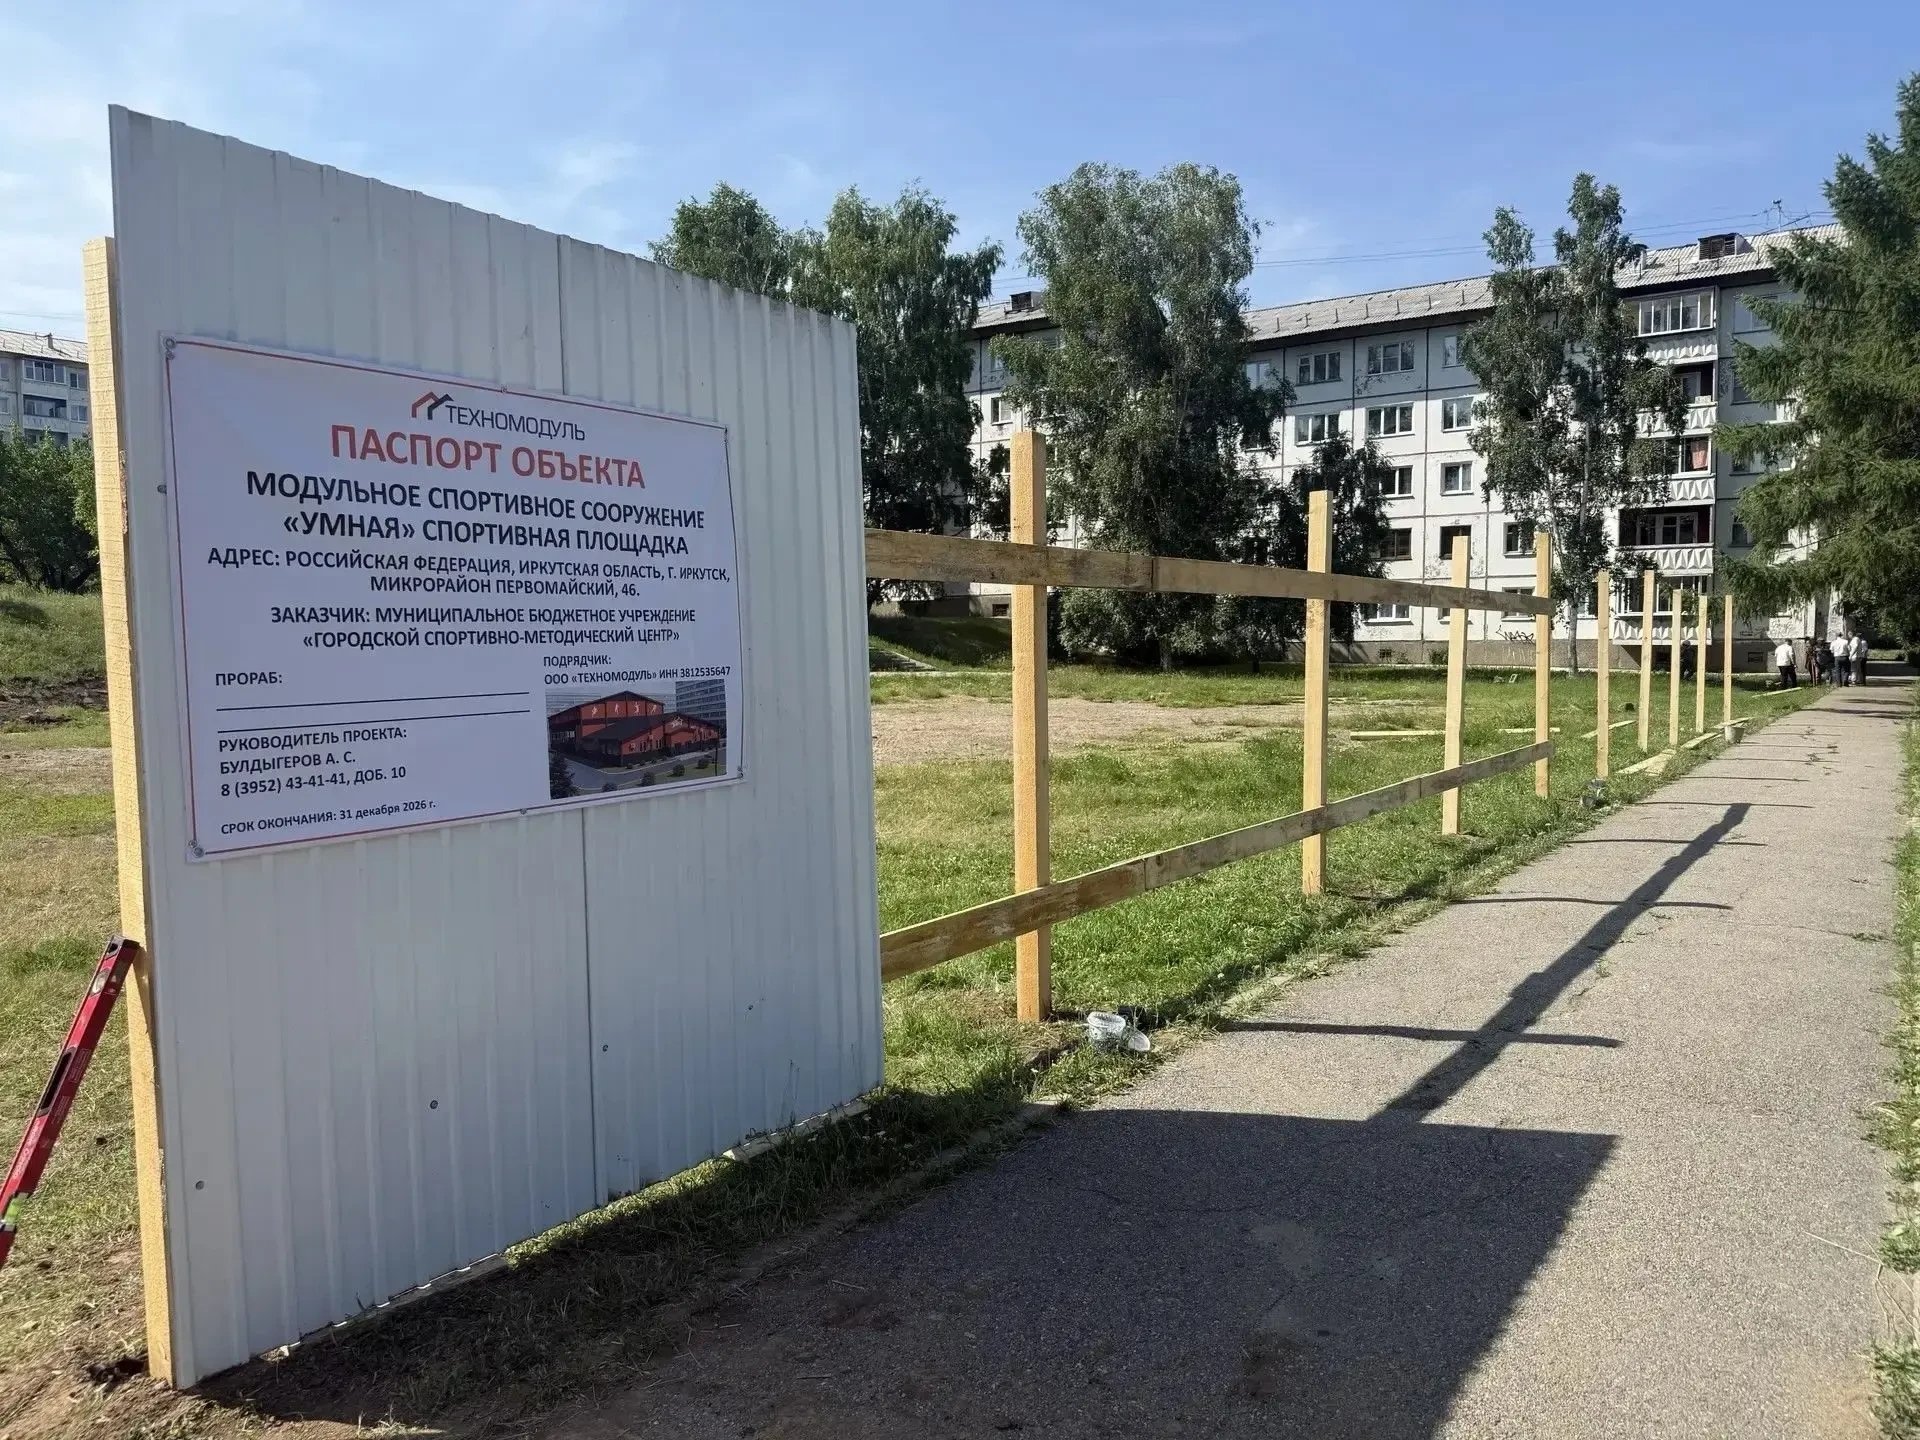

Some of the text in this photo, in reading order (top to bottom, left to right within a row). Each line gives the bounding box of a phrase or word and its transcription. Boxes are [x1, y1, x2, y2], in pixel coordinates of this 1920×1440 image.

[445, 404, 586, 441] ТЕХНОМОДУЛЬ
[331, 424, 646, 489] ПАСПОРТ ОБЪЕКТА
[246, 471, 705, 529] МОДУЛЬНОЕ СПОРТИВНОЕ СООРУЖЕНИЕ
[283, 511, 689, 558] «УМНАЯ» СПОРТИВНАЯ ПЛОЩАДКА
[207, 548, 731, 582] АДРЕС: РОССИЙСКАЯ ФЕДЕРАЦИЯ, ИРКУТСКАЯ ОБЛАСТЬ, Г. ИРКУТСК,
[370, 575, 640, 598] МИКРОРАЙОН ПЕРВОМАЙСКИЙ, 46.
[271, 606, 696, 625] ЗАКАЗЧИК: МУНИЦИПАЛЬНОЕ БЮДЖЕТНОЕ УЧРЕЖДЕНИЕ
[303, 627, 680, 650] «ГОРОДСКОЙ СПОРТИВНО-МЕТОДИЧЕСКИЙ ЦЕНТР»
[543, 655, 612, 668] ПОДРЯДЧИК:
[215, 671, 283, 686] ПРОРАБ:
[544, 666, 731, 685] ООО «ТЕХНОМОДУЛЬ» ИНН 3812535647
[219, 727, 407, 752] РУКОВОДИТЕЛЬ ПРОЕКТА:
[219, 751, 356, 775] БУЛДЫГЕРОВ А. С.
[220, 766, 407, 798] 8 (3952) 43-41-41, ДОБ. 10
[220, 800, 437, 835] СРОК ОКОНЧАНИЯ: 31 декабря 2026 г.
